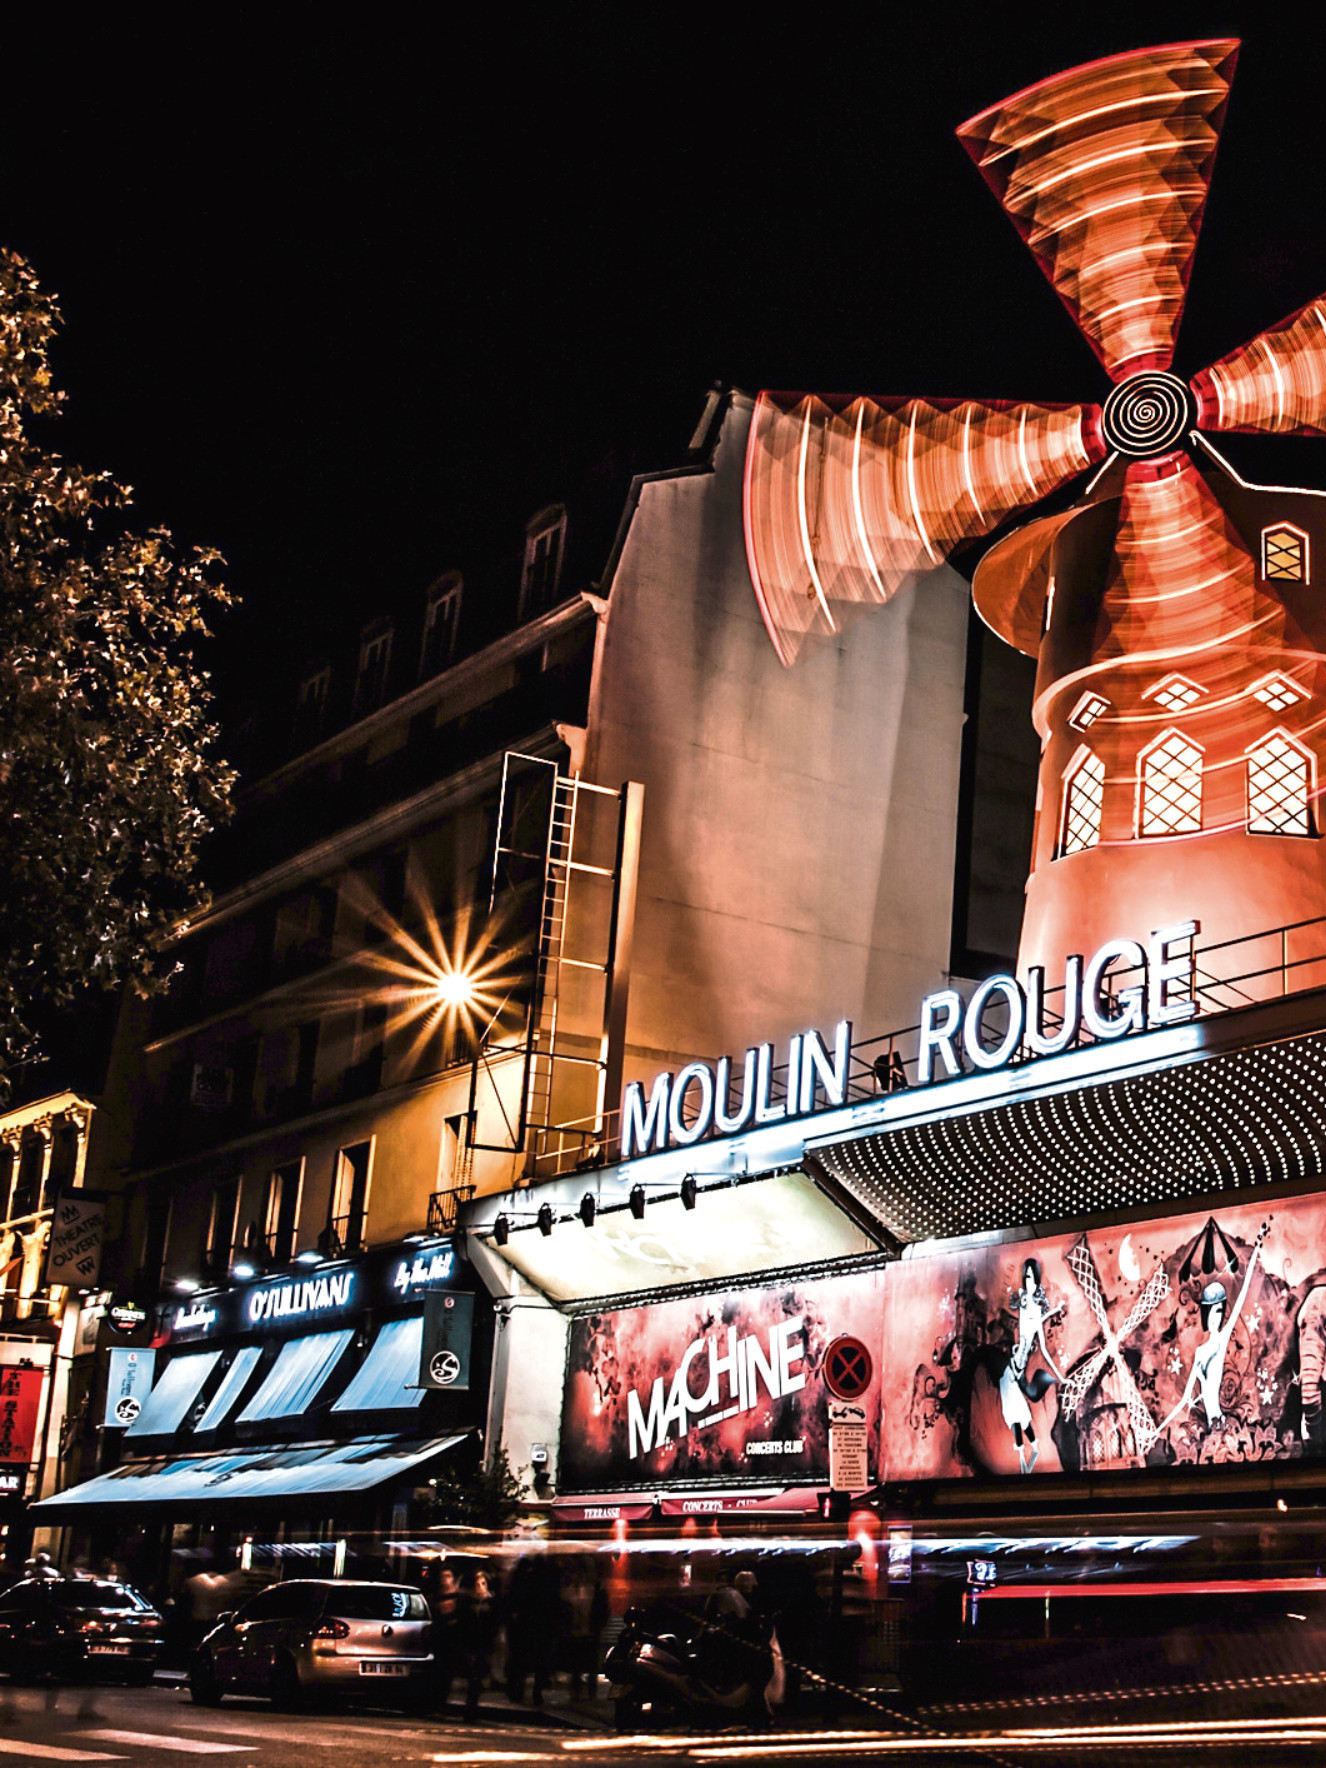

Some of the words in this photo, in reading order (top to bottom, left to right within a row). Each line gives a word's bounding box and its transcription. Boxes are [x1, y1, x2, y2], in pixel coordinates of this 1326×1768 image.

[621, 1020, 852, 1157] MOULIN
[917, 920, 1201, 1082] ROUGE
[53, 1233, 100, 1266] OUVERT
[250, 1273, 354, 1320] O'SULLIVANS
[627, 1315, 806, 1460] MACHINE
[584, 1508, 621, 1520] TERRASSE
[682, 1500, 723, 1512] CONCERTS
